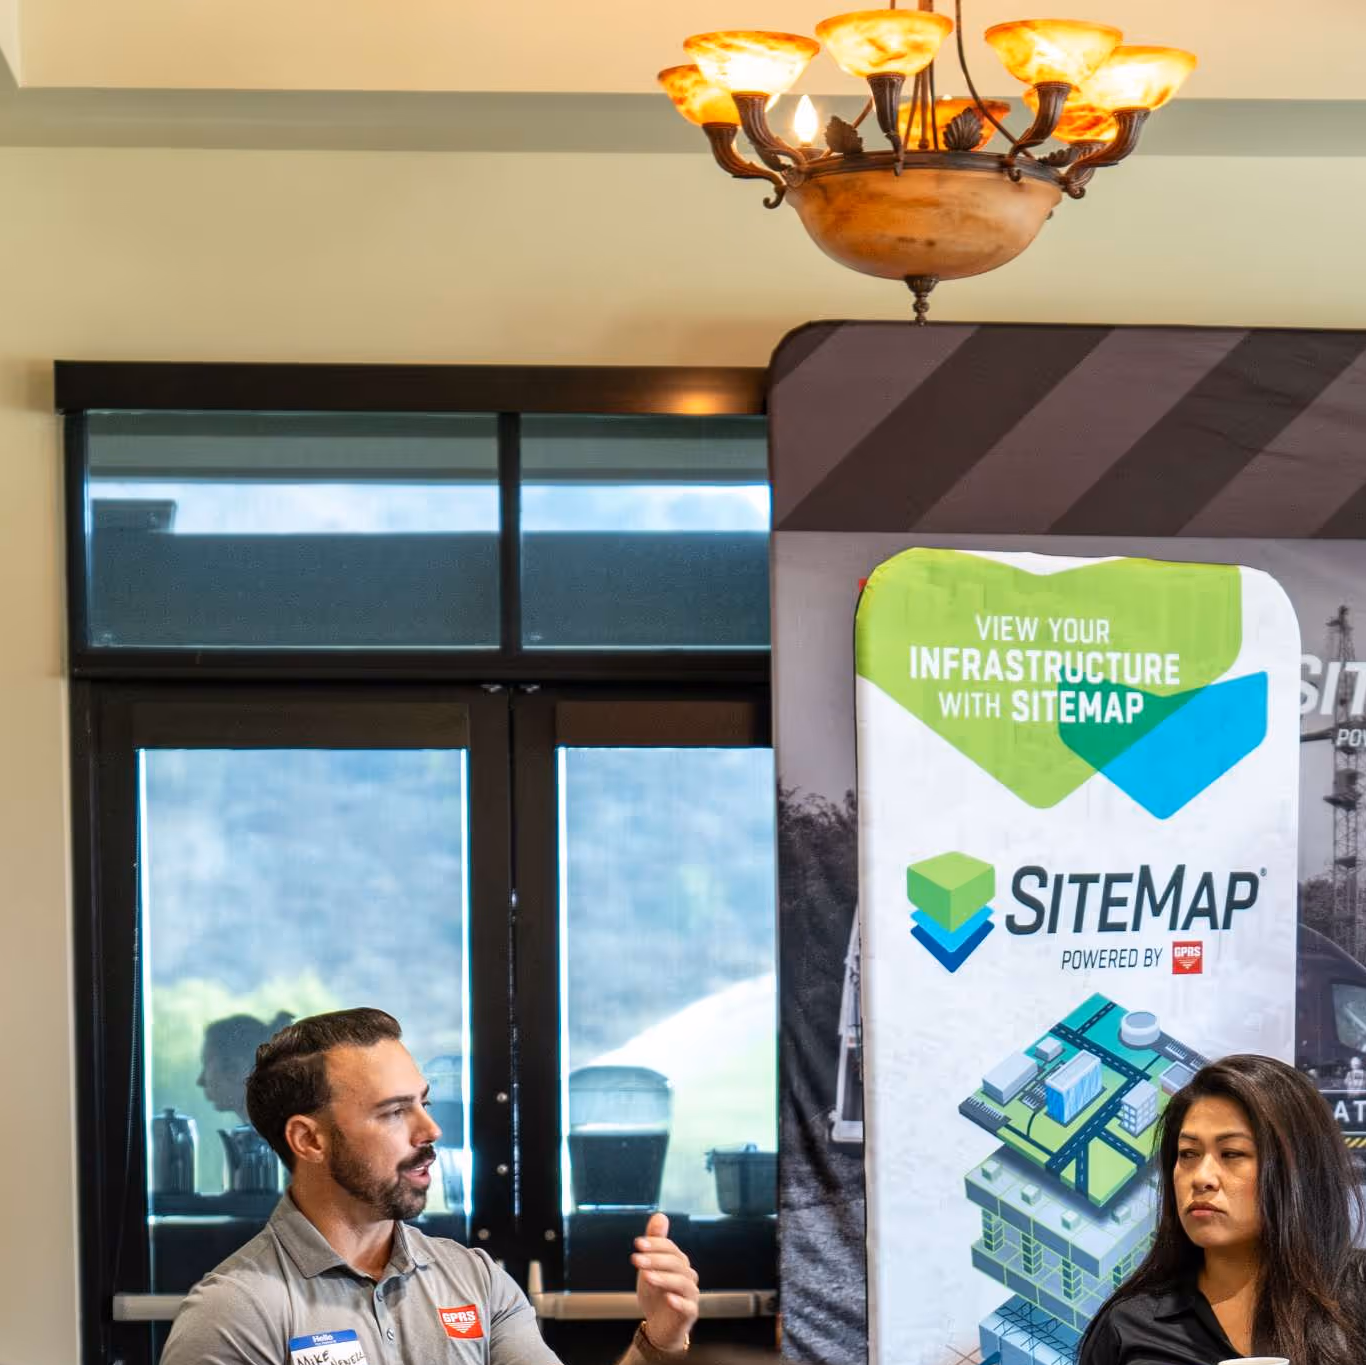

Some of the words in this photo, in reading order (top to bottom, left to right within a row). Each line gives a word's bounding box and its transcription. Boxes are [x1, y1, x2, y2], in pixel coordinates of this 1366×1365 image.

[975, 614, 1039, 641] VIEW
[1048, 617, 1110, 644] YOUR
[910, 646, 1180, 685] INFRASTRUCTURE
[939, 691, 1001, 718] WITH
[1011, 689, 1144, 724] SITEMAP
[1062, 948, 1138, 970] POWERED
[1143, 947, 1163, 967] BY
[442, 1310, 475, 1323] GPRS
